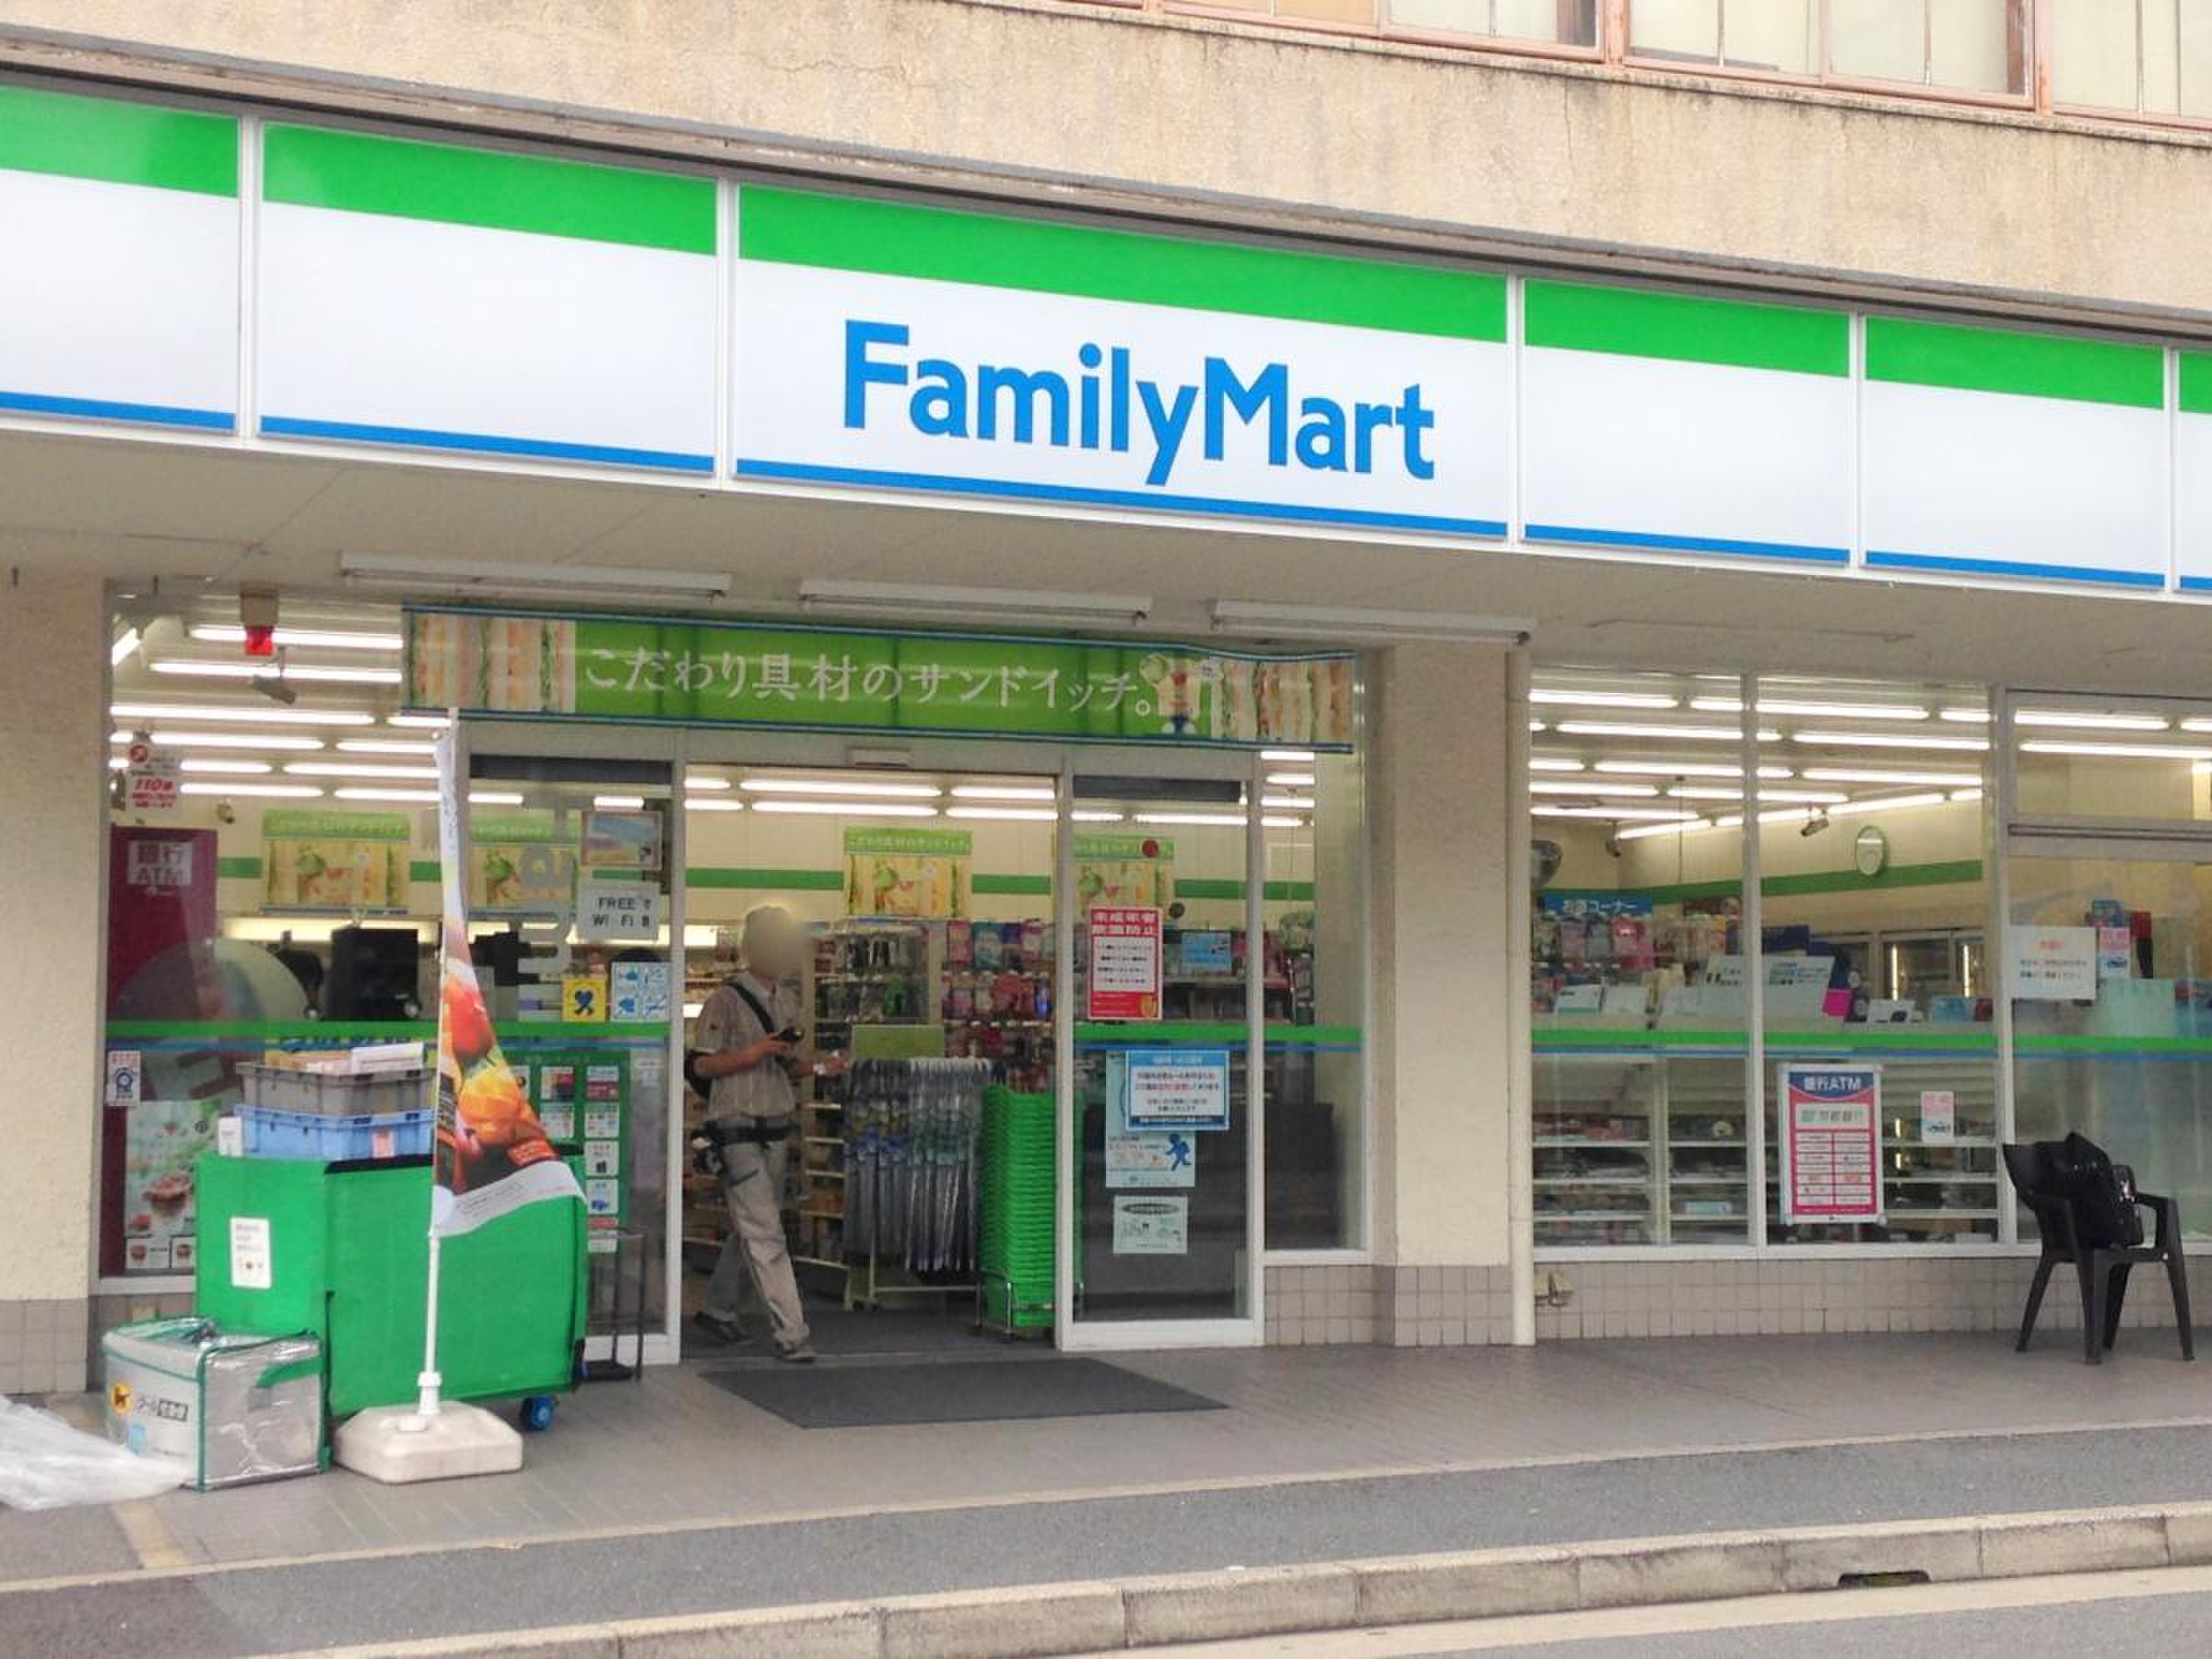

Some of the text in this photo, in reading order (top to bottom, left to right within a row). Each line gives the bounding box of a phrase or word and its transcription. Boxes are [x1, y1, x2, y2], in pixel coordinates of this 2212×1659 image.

[843, 319, 1434, 487] FamilyMart
[586, 647, 1151, 716] こだわり具材のサンドイッチ。
[598, 897, 635, 910] FREE
